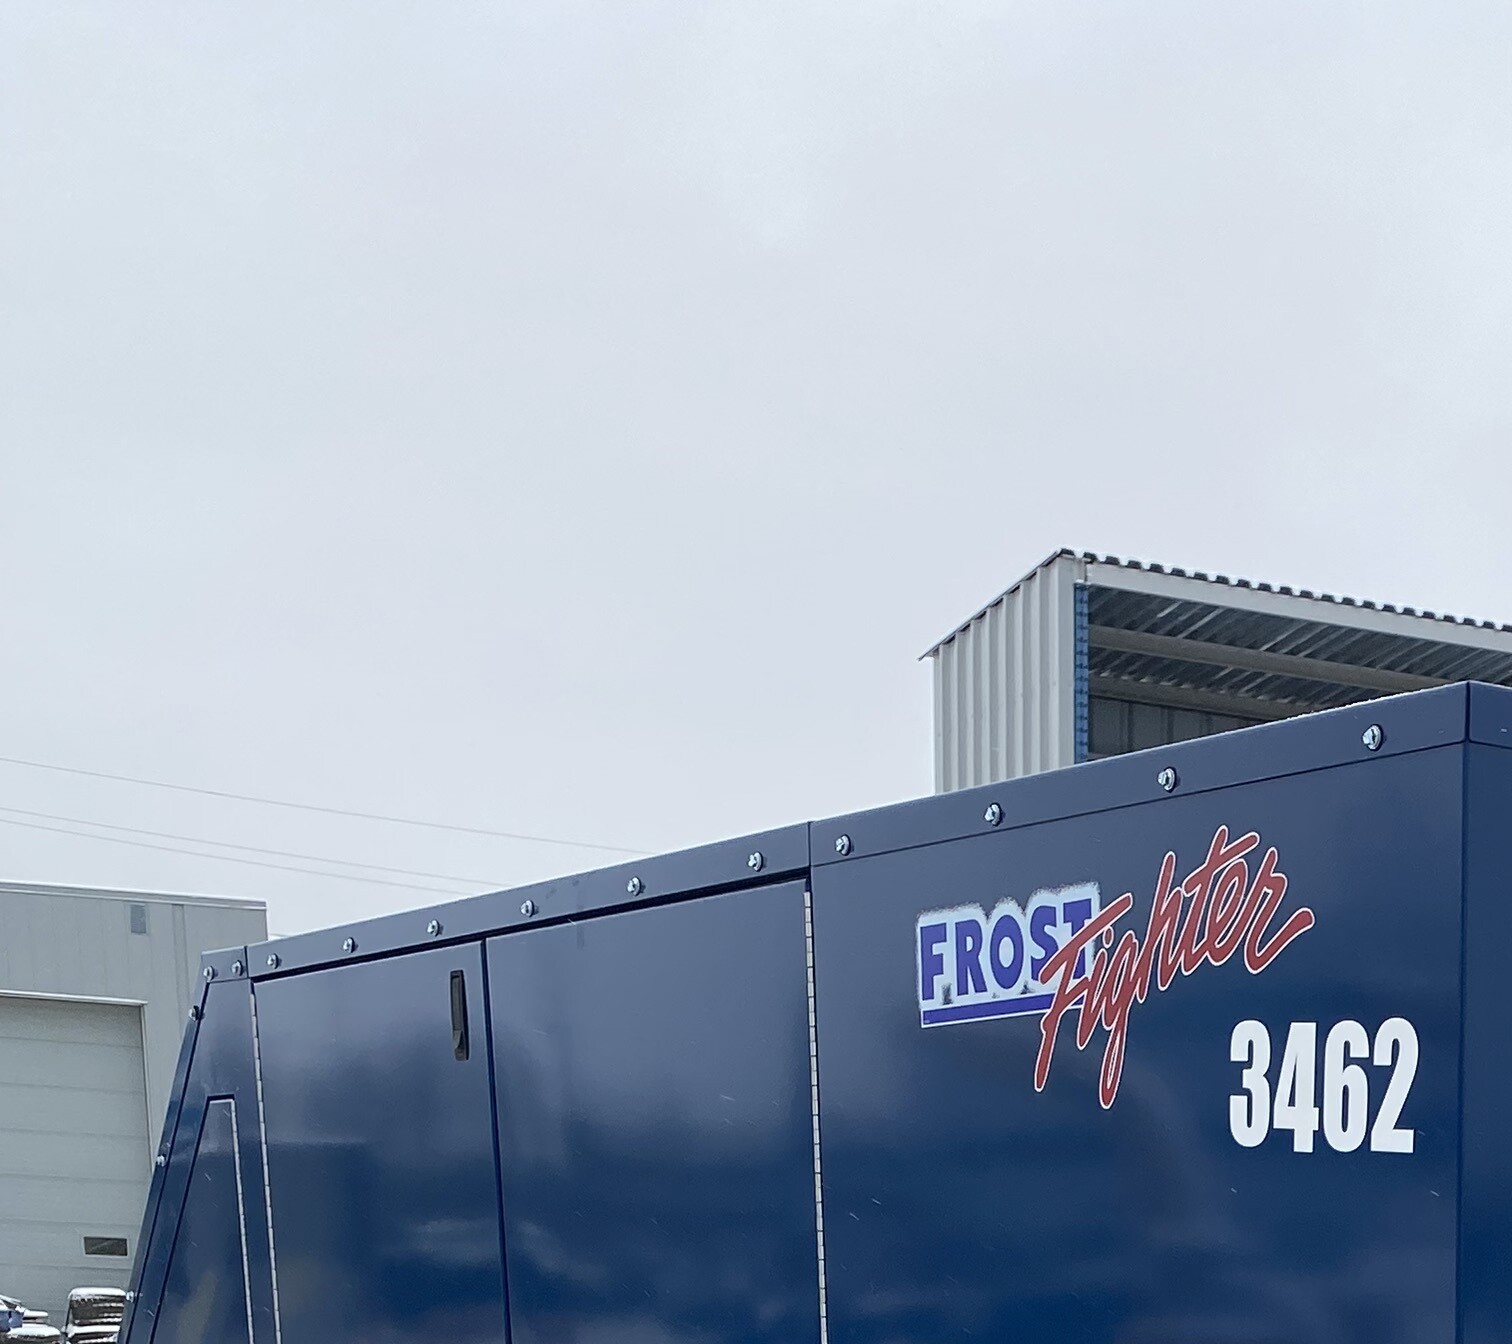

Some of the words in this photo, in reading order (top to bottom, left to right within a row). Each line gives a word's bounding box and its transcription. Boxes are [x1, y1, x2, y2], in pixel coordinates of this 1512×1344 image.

[919, 897, 1094, 1001] FROST
[1033, 824, 1316, 1110] Fighter
[1228, 1016, 1420, 1154] 3462
